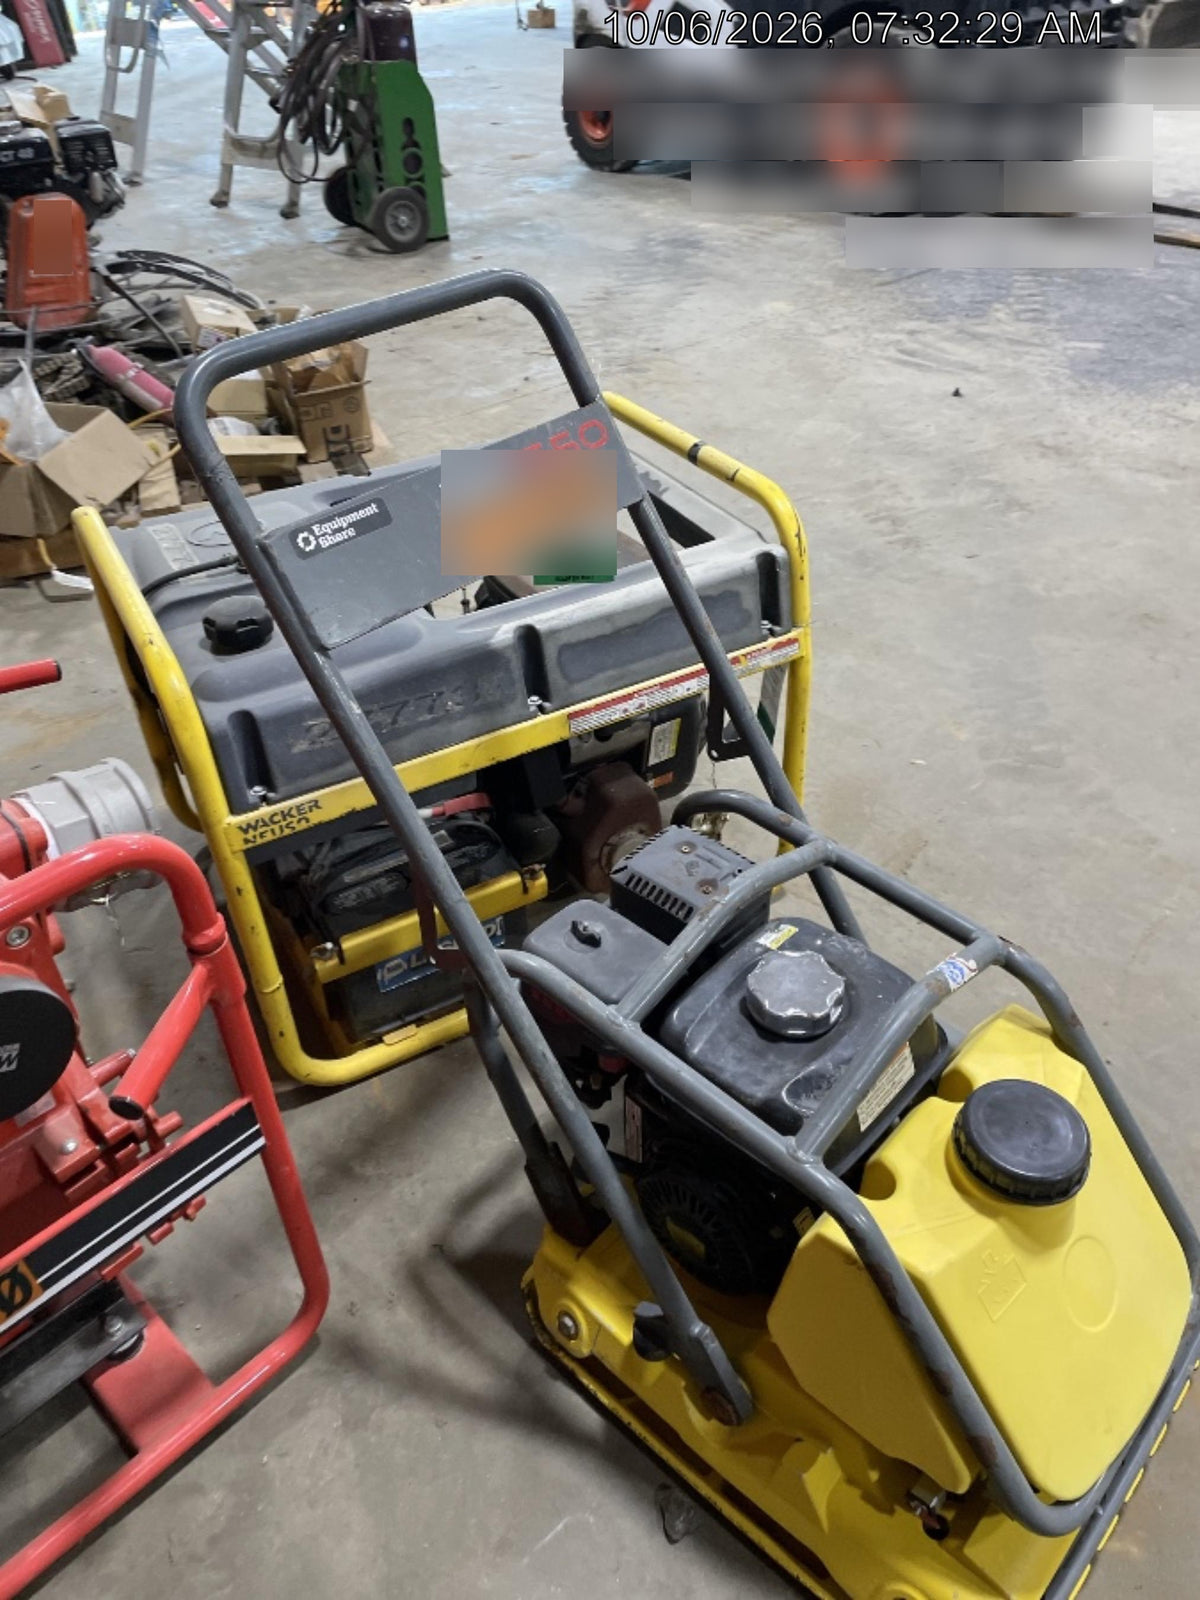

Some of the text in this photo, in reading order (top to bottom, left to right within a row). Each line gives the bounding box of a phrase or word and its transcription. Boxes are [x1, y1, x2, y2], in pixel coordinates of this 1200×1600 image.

[311, 502, 379, 536] Equipment
[318, 526, 356, 549] Share
[235, 799, 323, 836] WACKER
